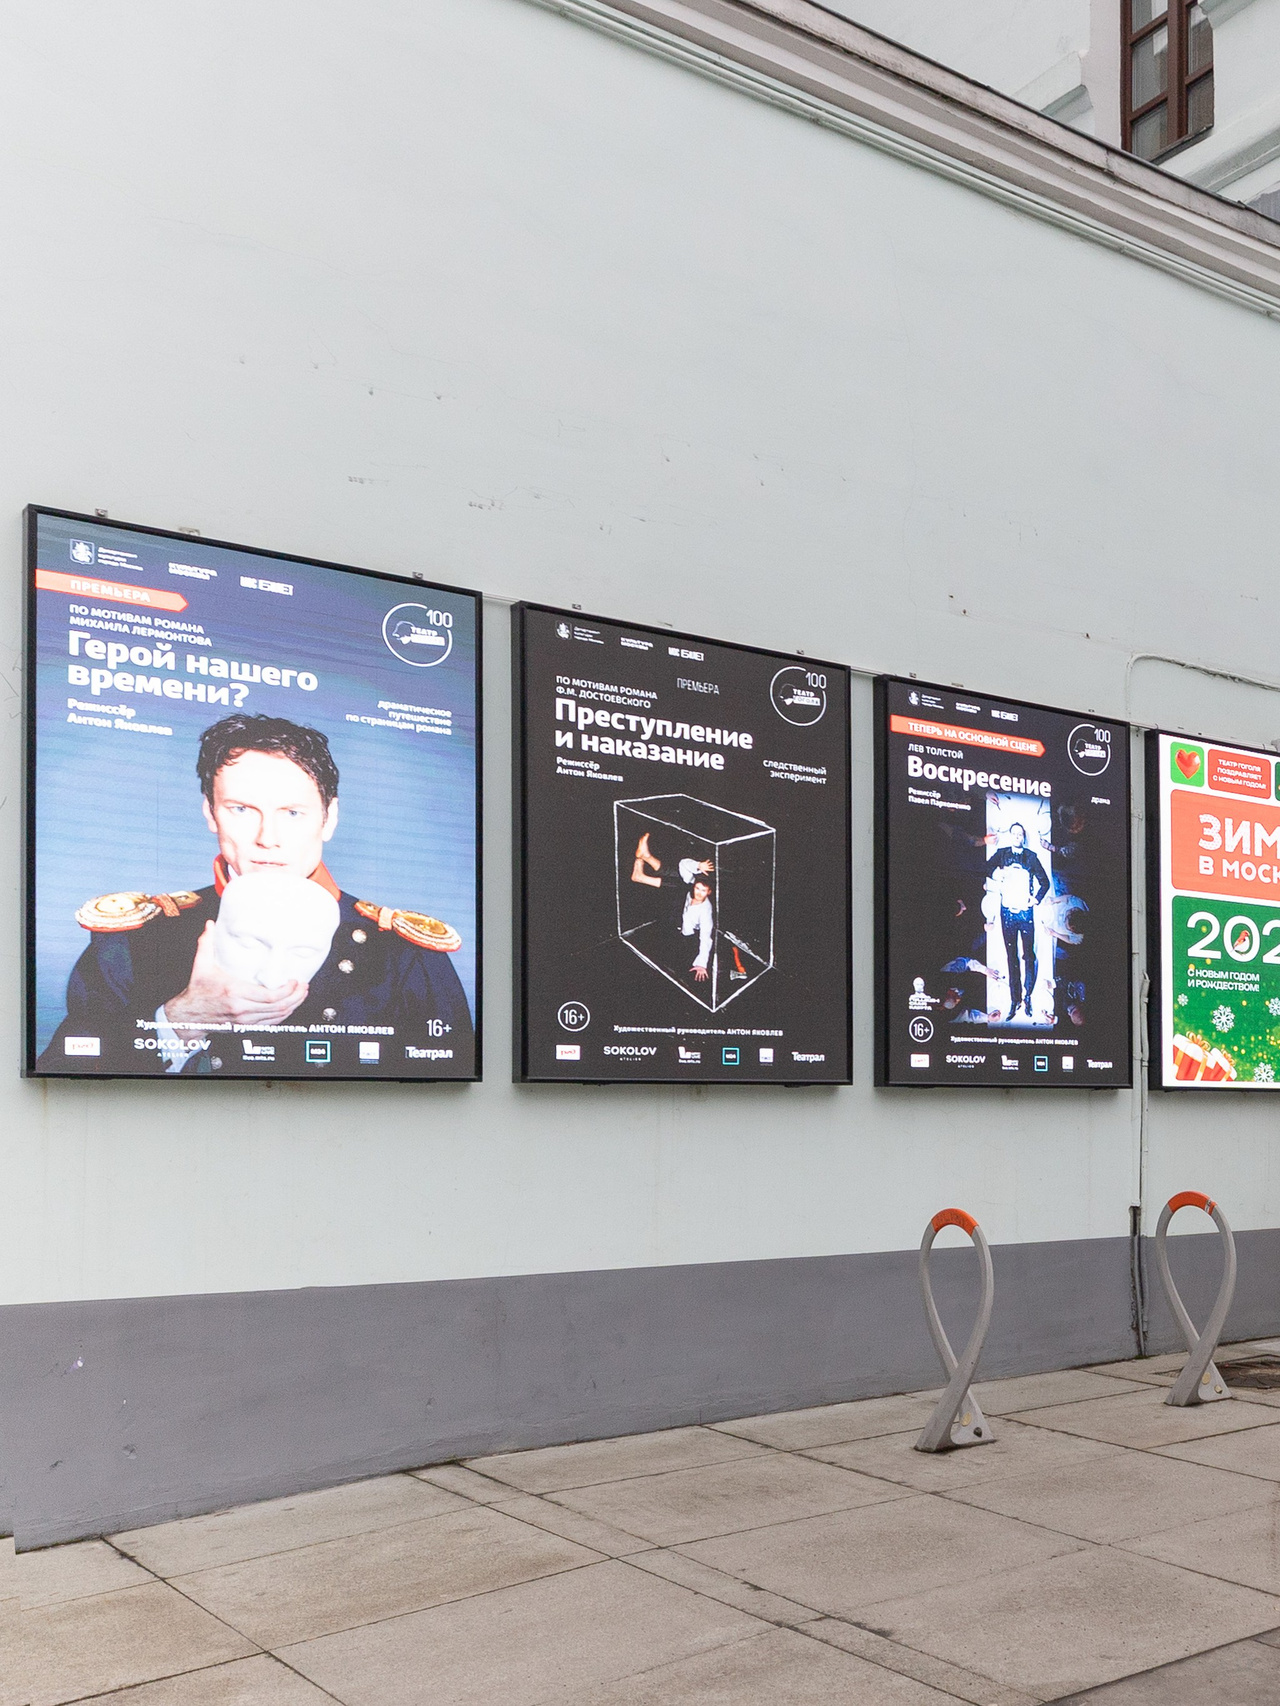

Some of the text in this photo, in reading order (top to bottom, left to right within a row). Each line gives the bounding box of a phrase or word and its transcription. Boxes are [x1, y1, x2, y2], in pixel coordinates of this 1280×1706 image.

[70, 579, 151, 603] ПРЕМЬЕРА
[69, 604, 205, 634] ПО МОТИВАМ РОМАНА
[426, 609, 453, 628] 100
[69, 616, 212, 647] МИХАИЛА ЛЕРМОНТОВА
[68, 629, 318, 692] Герой нашего
[68, 663, 250, 708] времени?
[556, 676, 658, 699] ПО МОТИВАМ РОМАНА
[677, 678, 719, 695] ПРЕМЬЕРА
[805, 672, 826, 689] 100
[556, 686, 651, 709] Ф.М. ДОСТОЕВСКОГО
[793, 688, 814, 697] ТЕАТР
[67, 698, 136, 719] Режиссёр
[377, 700, 452, 717] драматическое
[67, 713, 173, 736] Антон Яковлев
[345, 714, 452, 735] по страницам романа
[388, 711, 452, 726] путешествие
[555, 698, 753, 749] Преступление
[908, 722, 1038, 753] ТЕПЕРЬ НА ОСНОВНОЙ СЦЕНЕ
[1094, 728, 1111, 743] 100
[555, 731, 725, 770] и наказание
[908, 743, 964, 759] ЛЕВ ТОЛСТОЙ
[556, 756, 600, 771] Режиссёр
[763, 759, 827, 775] следственный
[1218, 758, 1261, 772] ТЕАТР ГОГОЛЯ
[556, 766, 624, 782] Антон Яковлев
[770, 770, 827, 784] эксперимент
[908, 755, 1052, 797] Воскресение
[1217, 767, 1262, 780] ПОЗДРАВЛЯЕТ
[1218, 776, 1243, 785] НОВЫМ
[1198, 855, 1214, 875] В
[1195, 969, 1229, 979] НОВЫМ
[1229, 972, 1260, 981] ГОДОМ
[1187, 979, 1260, 992] И РОЖДЕСТВОМ!
[563, 1009, 585, 1025] 16+
[136, 1019, 394, 1035] Художественный руководитель АНТОН ЯКОВЛЕВ
[426, 1019, 453, 1037] 16+
[613, 1025, 676, 1033] Художественный
[677, 1027, 726, 1035] руководитель
[913, 1023, 930, 1037] 16+
[133, 1038, 211, 1051] SOKOLOV
[603, 1046, 657, 1056] SOKOLOV
[405, 1046, 453, 1060] Театрал
[791, 1051, 825, 1063] Театрал
[945, 1055, 986, 1063] SOKOLOV
